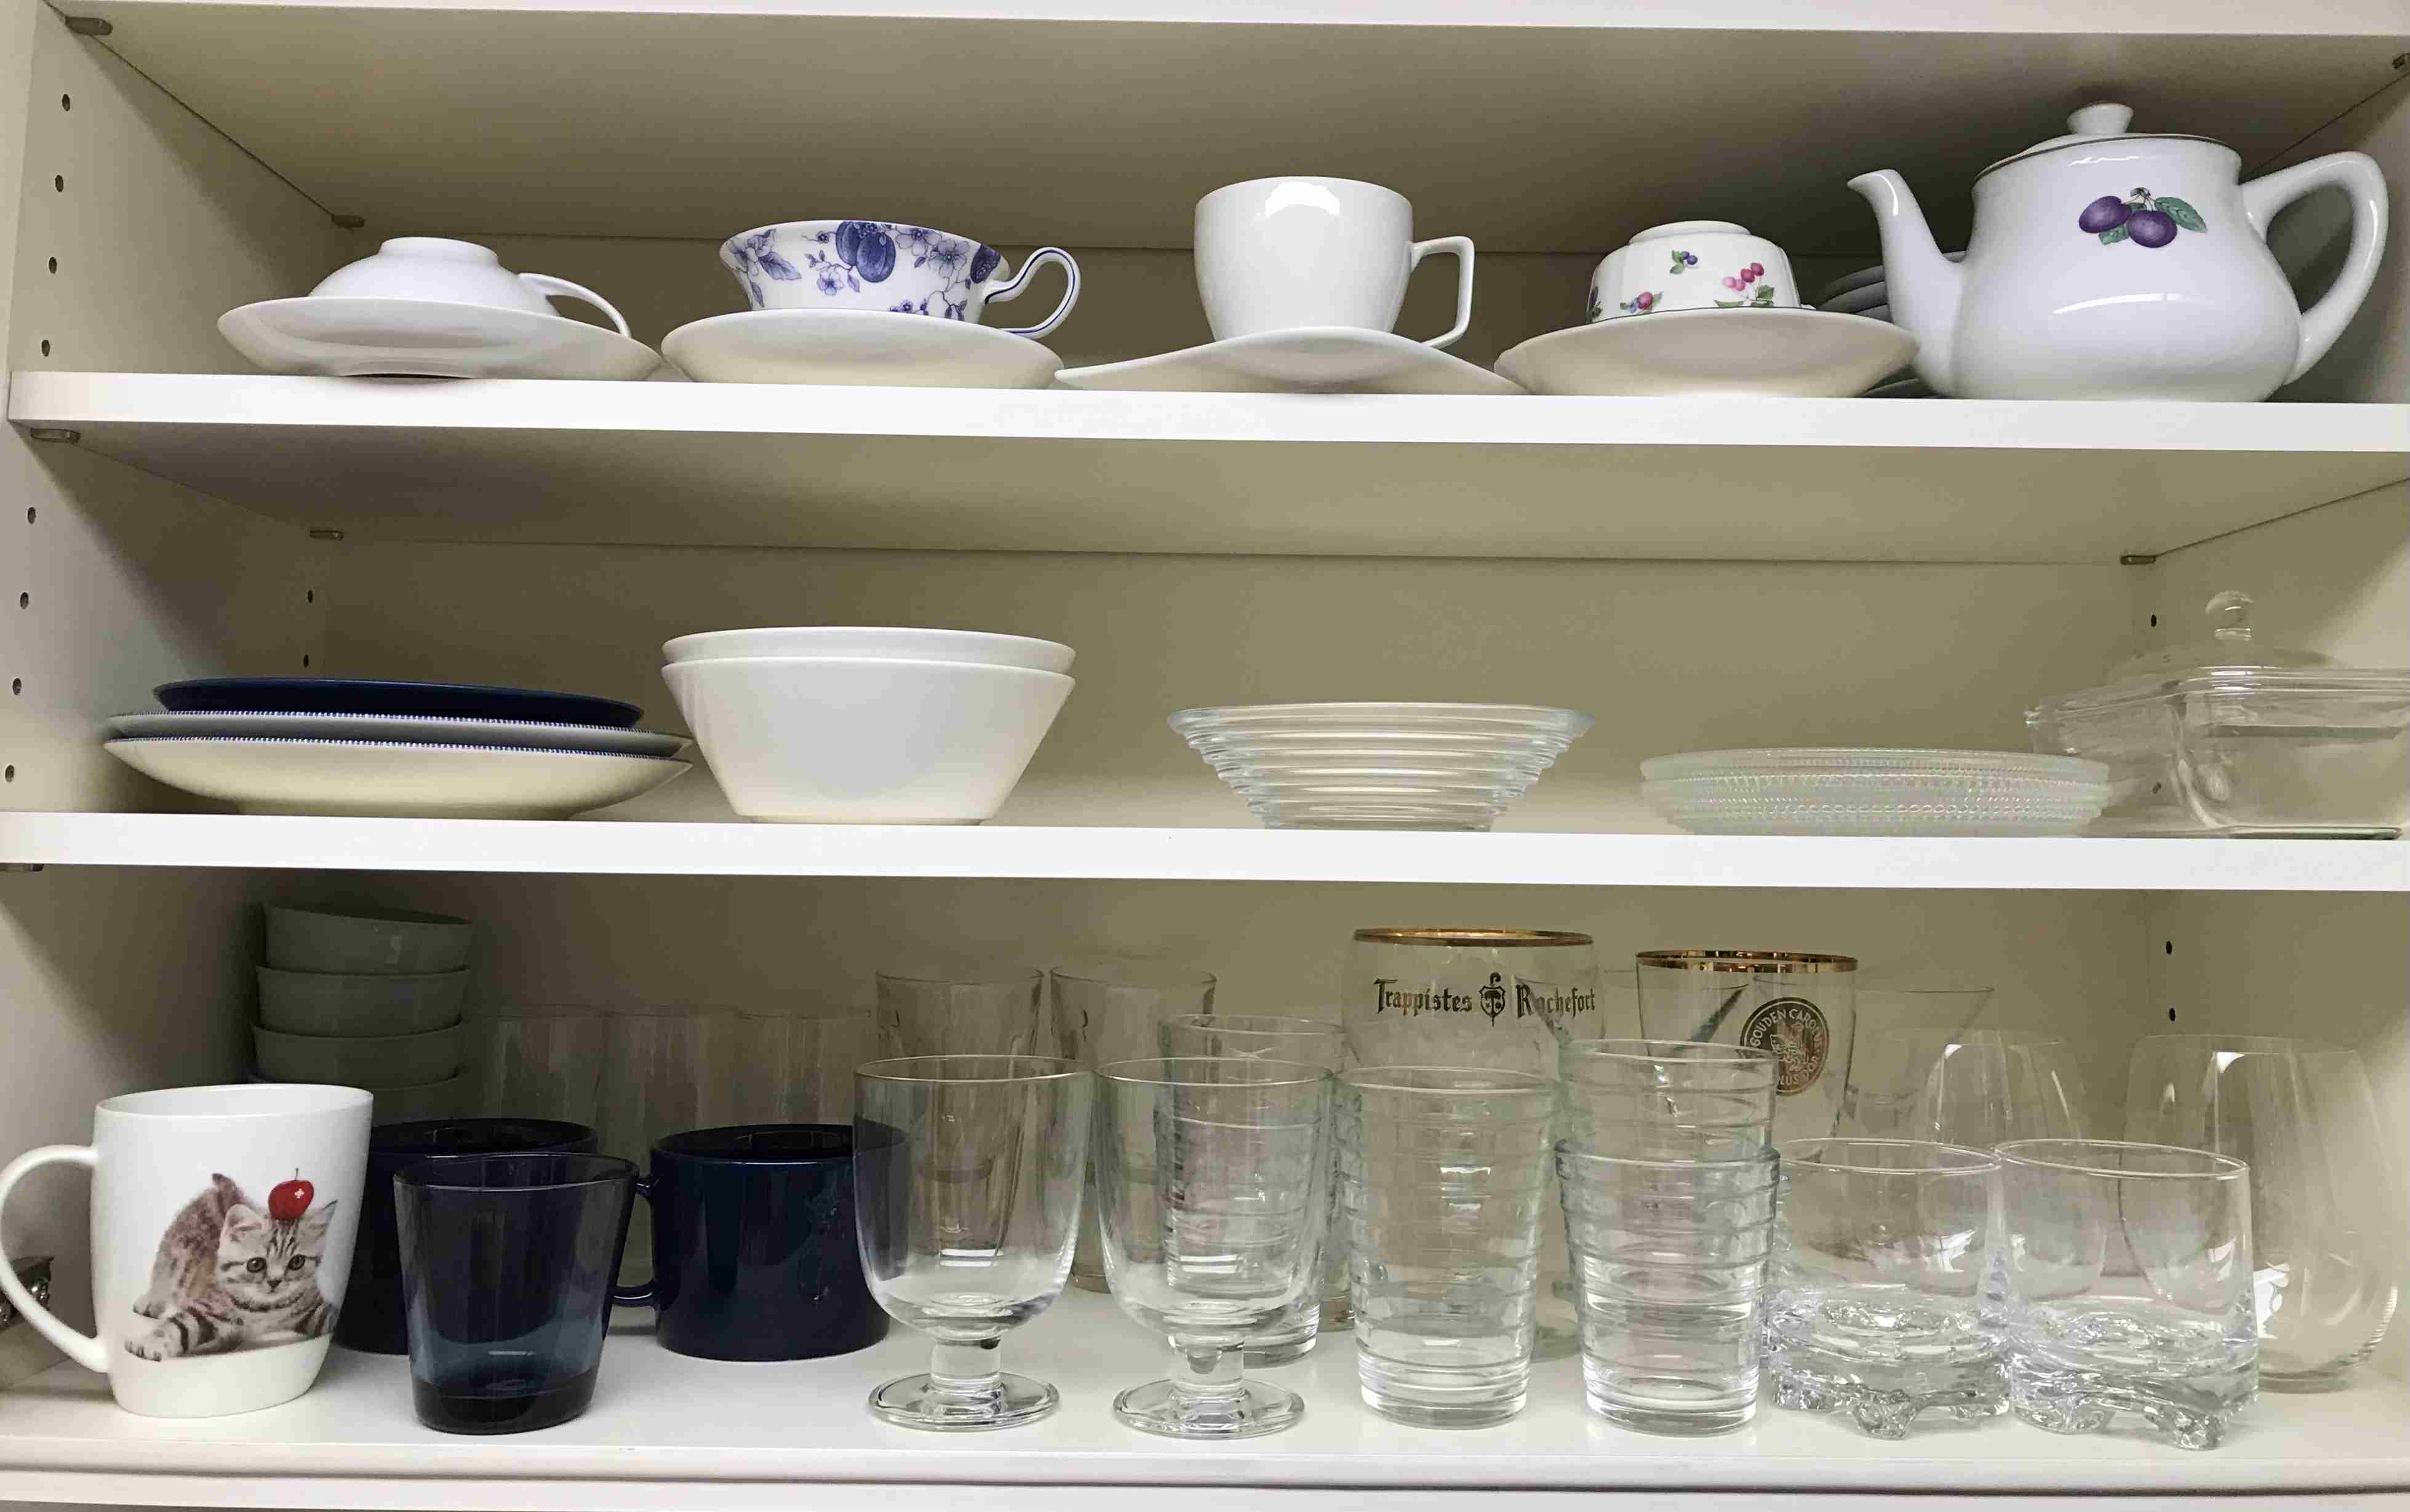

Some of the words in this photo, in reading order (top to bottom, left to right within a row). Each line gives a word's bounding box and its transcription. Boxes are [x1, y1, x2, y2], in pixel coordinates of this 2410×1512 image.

[1373, 978, 1473, 1017] Trappistes
[1515, 984, 1595, 1019] Rochefort
[1749, 1009, 1787, 1048] GOUDEN
[1789, 1008, 1822, 1046] CAROLUS
